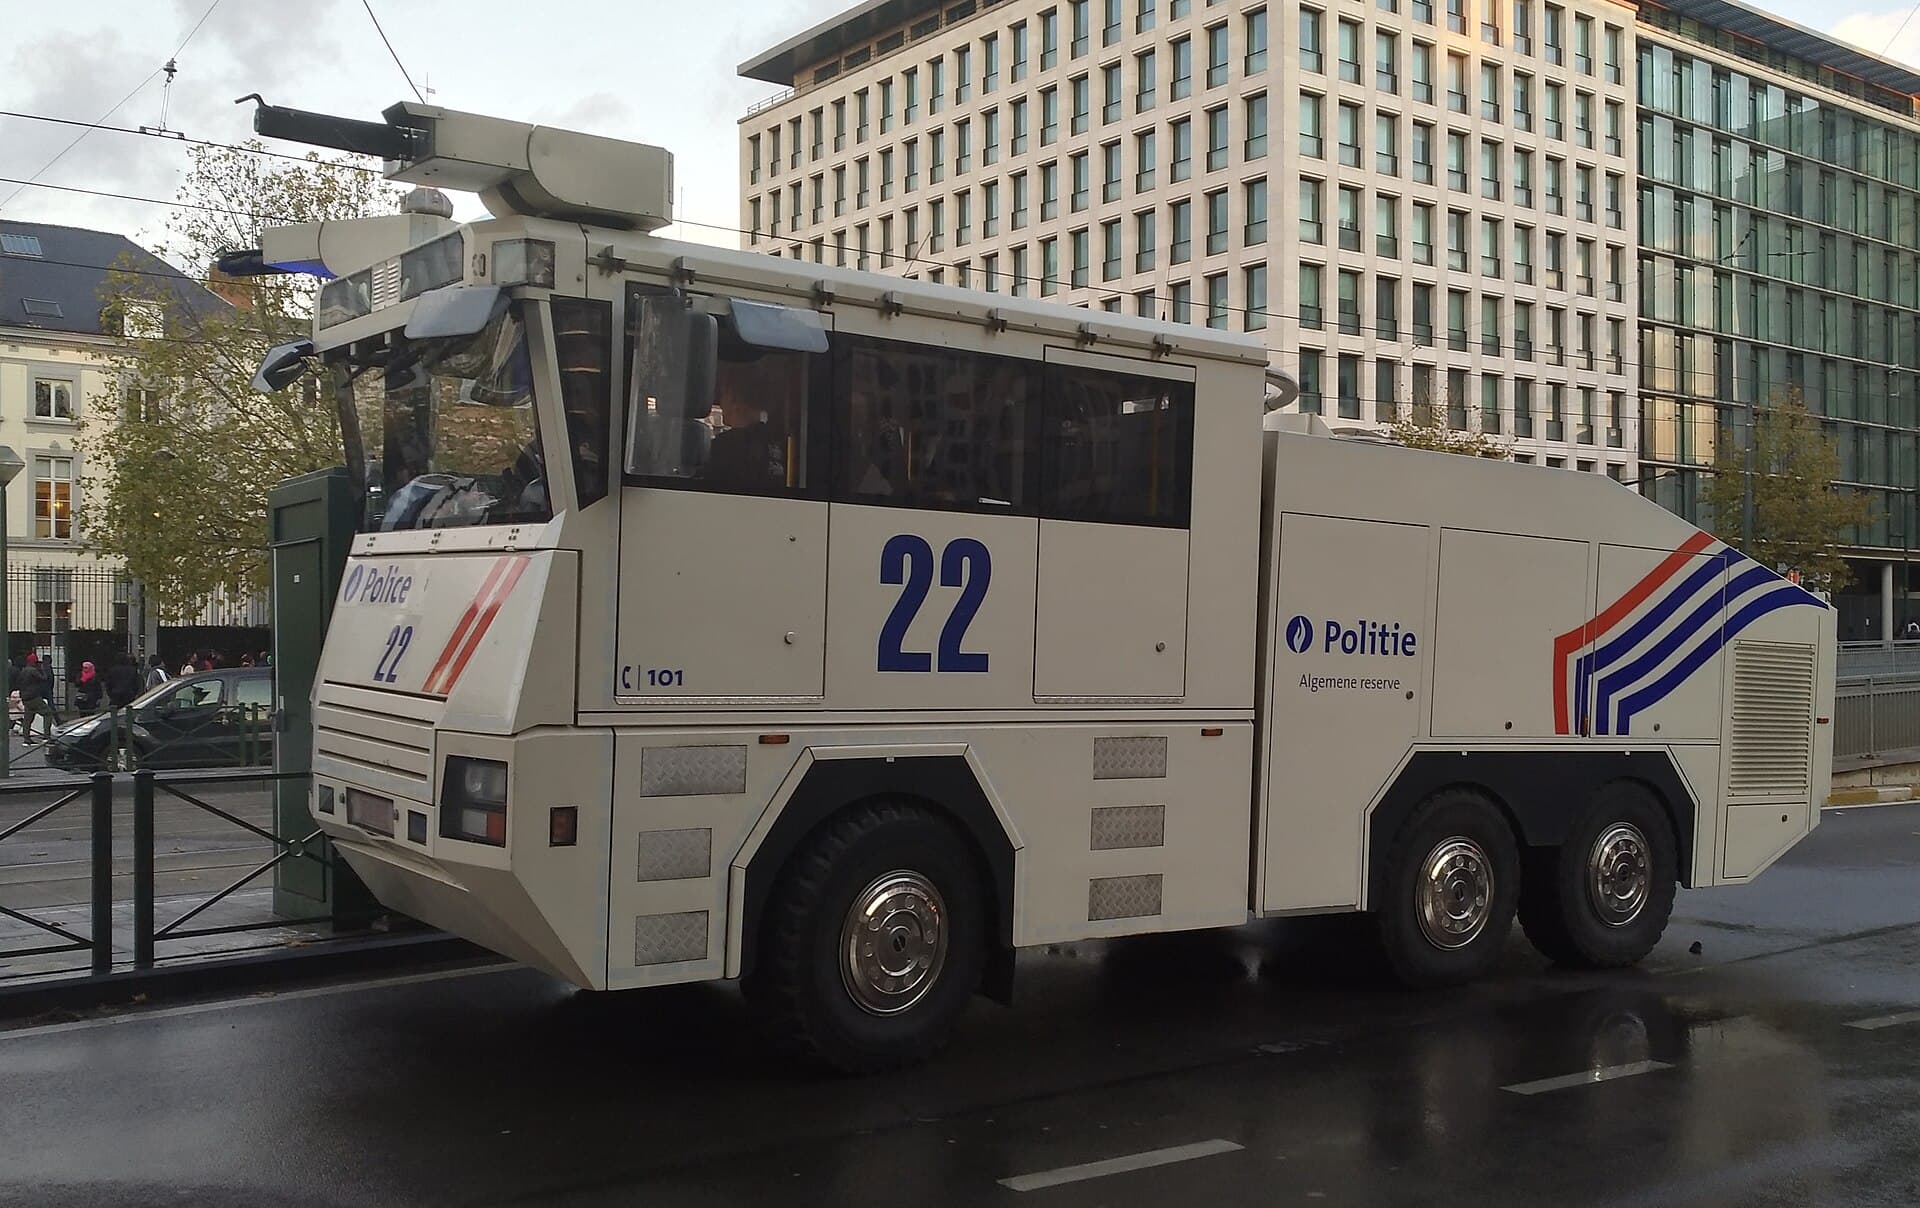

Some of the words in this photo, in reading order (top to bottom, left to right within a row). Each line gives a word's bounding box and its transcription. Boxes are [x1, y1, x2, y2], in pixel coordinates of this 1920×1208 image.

[360, 565, 412, 604] Police
[877, 534, 992, 673] 22
[373, 625, 413, 683] 22
[1325, 620, 1417, 656] Politie
[647, 669, 683, 686] 101
[1299, 673, 1357, 692] Algemene
[1360, 678, 1400, 690] reserve
